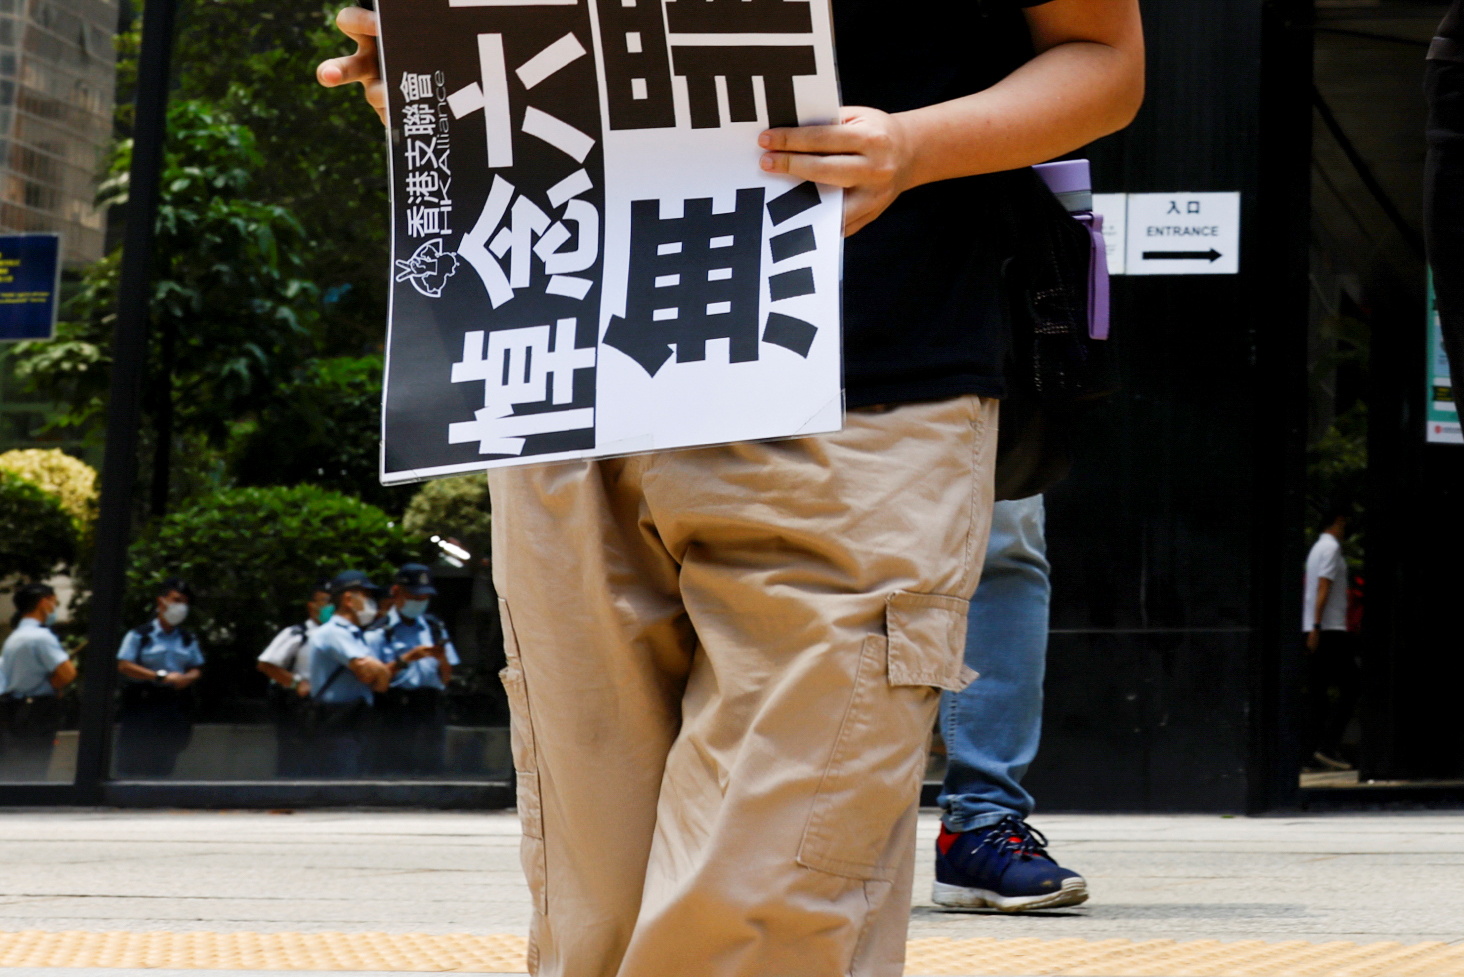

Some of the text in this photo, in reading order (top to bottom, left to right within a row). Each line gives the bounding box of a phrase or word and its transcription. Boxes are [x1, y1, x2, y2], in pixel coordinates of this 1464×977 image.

[400, 71, 440, 238] 香港支聯會
[1167, 200, 1200, 214] 入口
[1146, 226, 1219, 237] ENTRANCE
